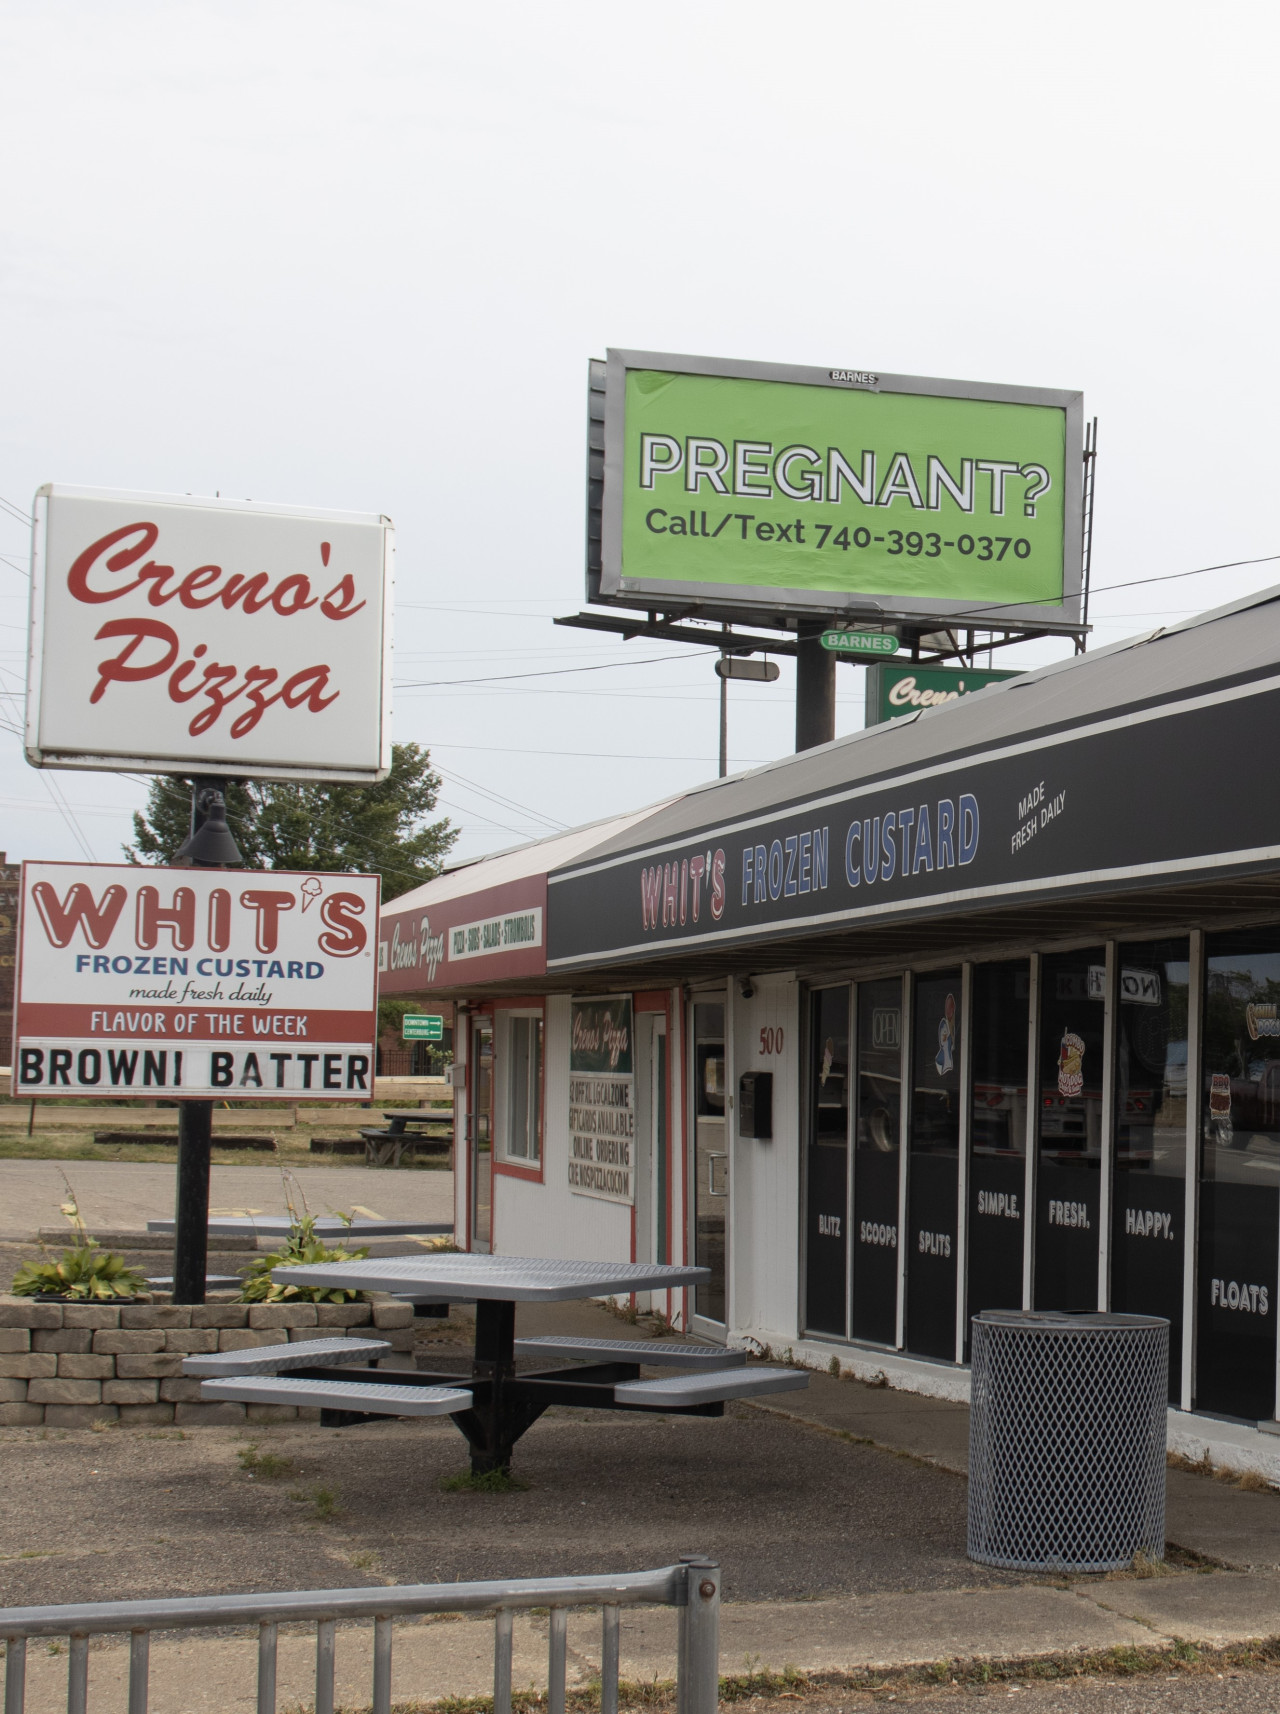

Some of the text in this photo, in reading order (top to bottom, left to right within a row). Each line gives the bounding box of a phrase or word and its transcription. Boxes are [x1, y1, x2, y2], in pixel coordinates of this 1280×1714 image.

[831, 371, 876, 384] BARNES
[639, 432, 1052, 518] PREGNANT?
[645, 507, 1032, 562] Call/Text 740-393-0370
[67, 521, 367, 621] Creno's
[827, 634, 892, 650] BARNES
[89, 617, 340, 740] Pizza
[888, 676, 971, 706] Creno'
[1017, 780, 1046, 821] MADE
[1010, 789, 1067, 855] FRESH DAILY
[640, 793, 980, 931] WHIT'S FROZEN CUSTARD
[31, 877, 368, 958] WHIT'S
[483, 921, 501, 949] SALADS
[503, 914, 535, 945] STROMBOLIS
[419, 915, 444, 982] Pizza
[75, 954, 325, 980] FROZEN CUSTARD
[129, 980, 273, 1005] made fresh daily
[90, 1011, 308, 1036] FLAVOR OF THE WEEK
[601, 1010, 629, 1066] Pizza
[874, 1013, 900, 1044] OPEN
[758, 1026, 784, 1055] 500
[20, 1047, 369, 1090] BROWNI BATTER
[1212, 1074, 1230, 1089] BBQ
[598, 1111, 633, 1137] AVAILABLE
[573, 1136, 629, 1166] ONLINE ORDERING
[977, 1190, 1021, 1220] SIMPLE.
[1048, 1200, 1091, 1230] FRESH.
[818, 1214, 841, 1238] BLITZ
[860, 1221, 897, 1249] SCOOPS
[1125, 1208, 1175, 1241] HAPPY.
[918, 1230, 951, 1258] SPLITS
[1210, 1277, 1269, 1316] FLOATS
